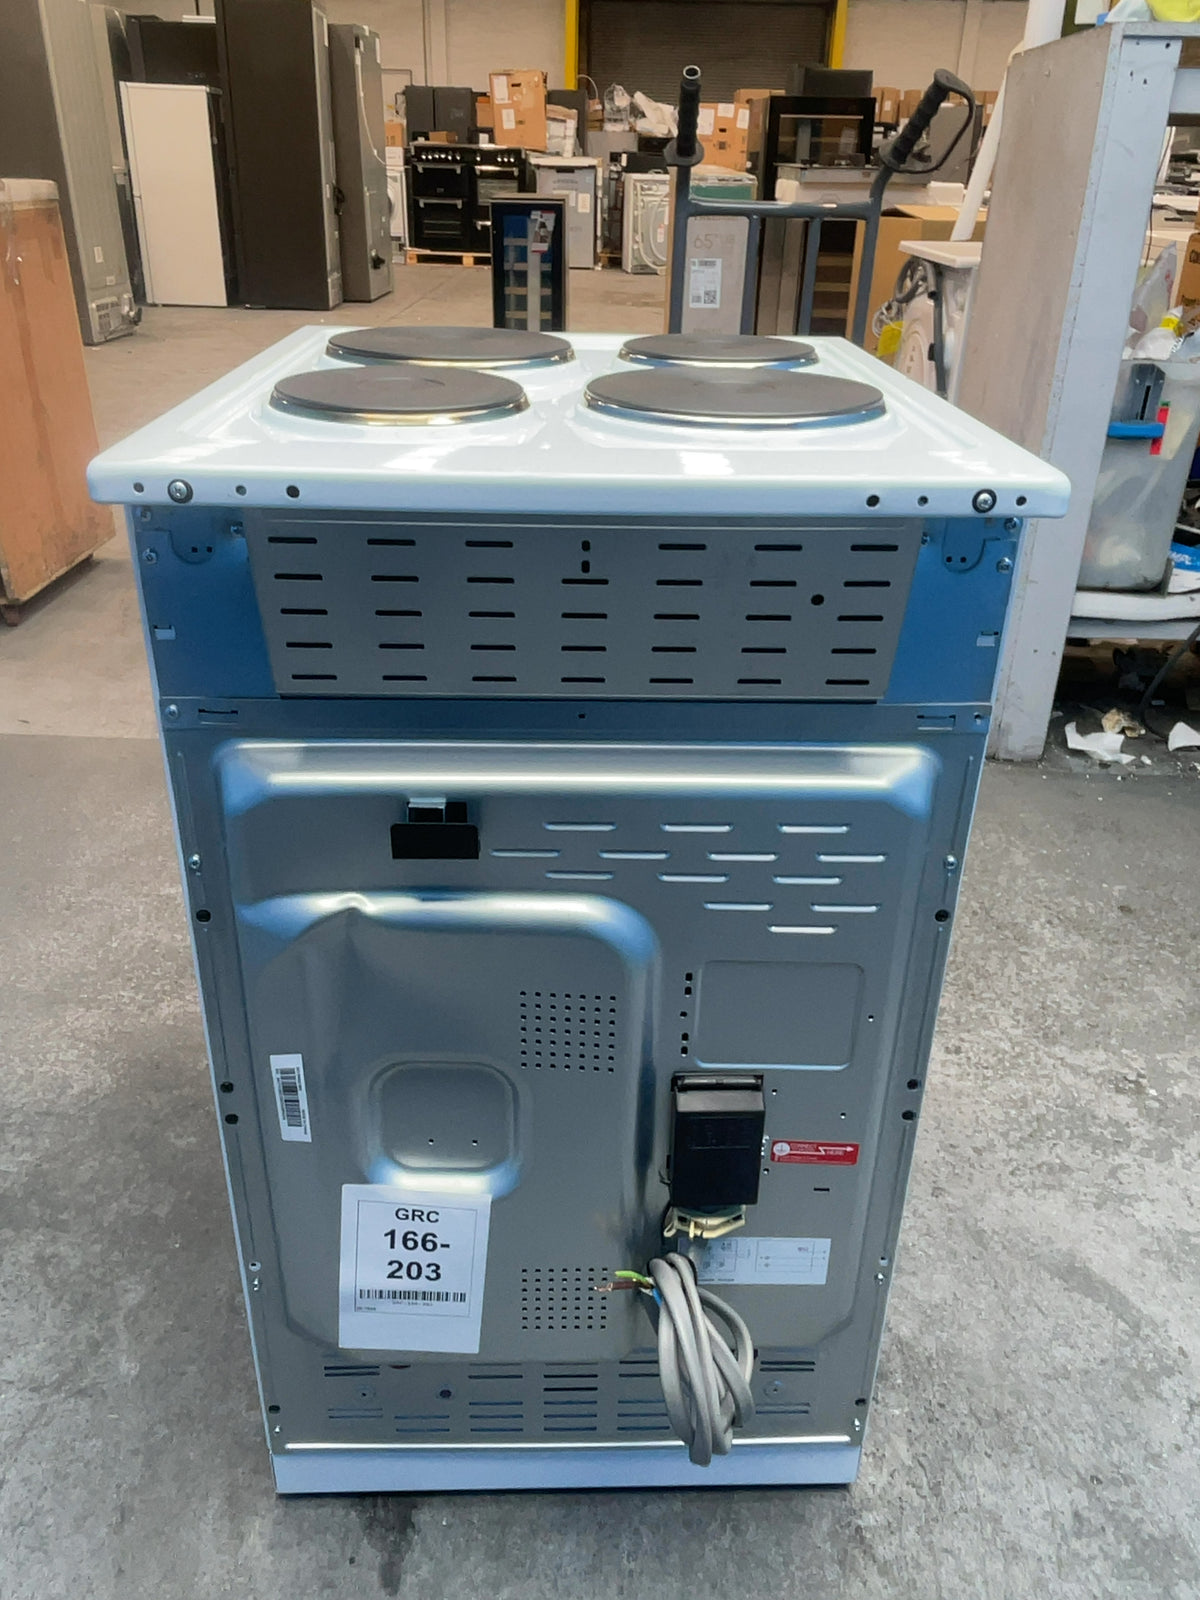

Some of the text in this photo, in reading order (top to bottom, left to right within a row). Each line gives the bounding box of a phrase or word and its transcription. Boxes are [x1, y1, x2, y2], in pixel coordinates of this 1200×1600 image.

[395, 1207, 440, 1223] GRC
[383, 1228, 451, 1252] 166-
[386, 1259, 442, 1282] 203
